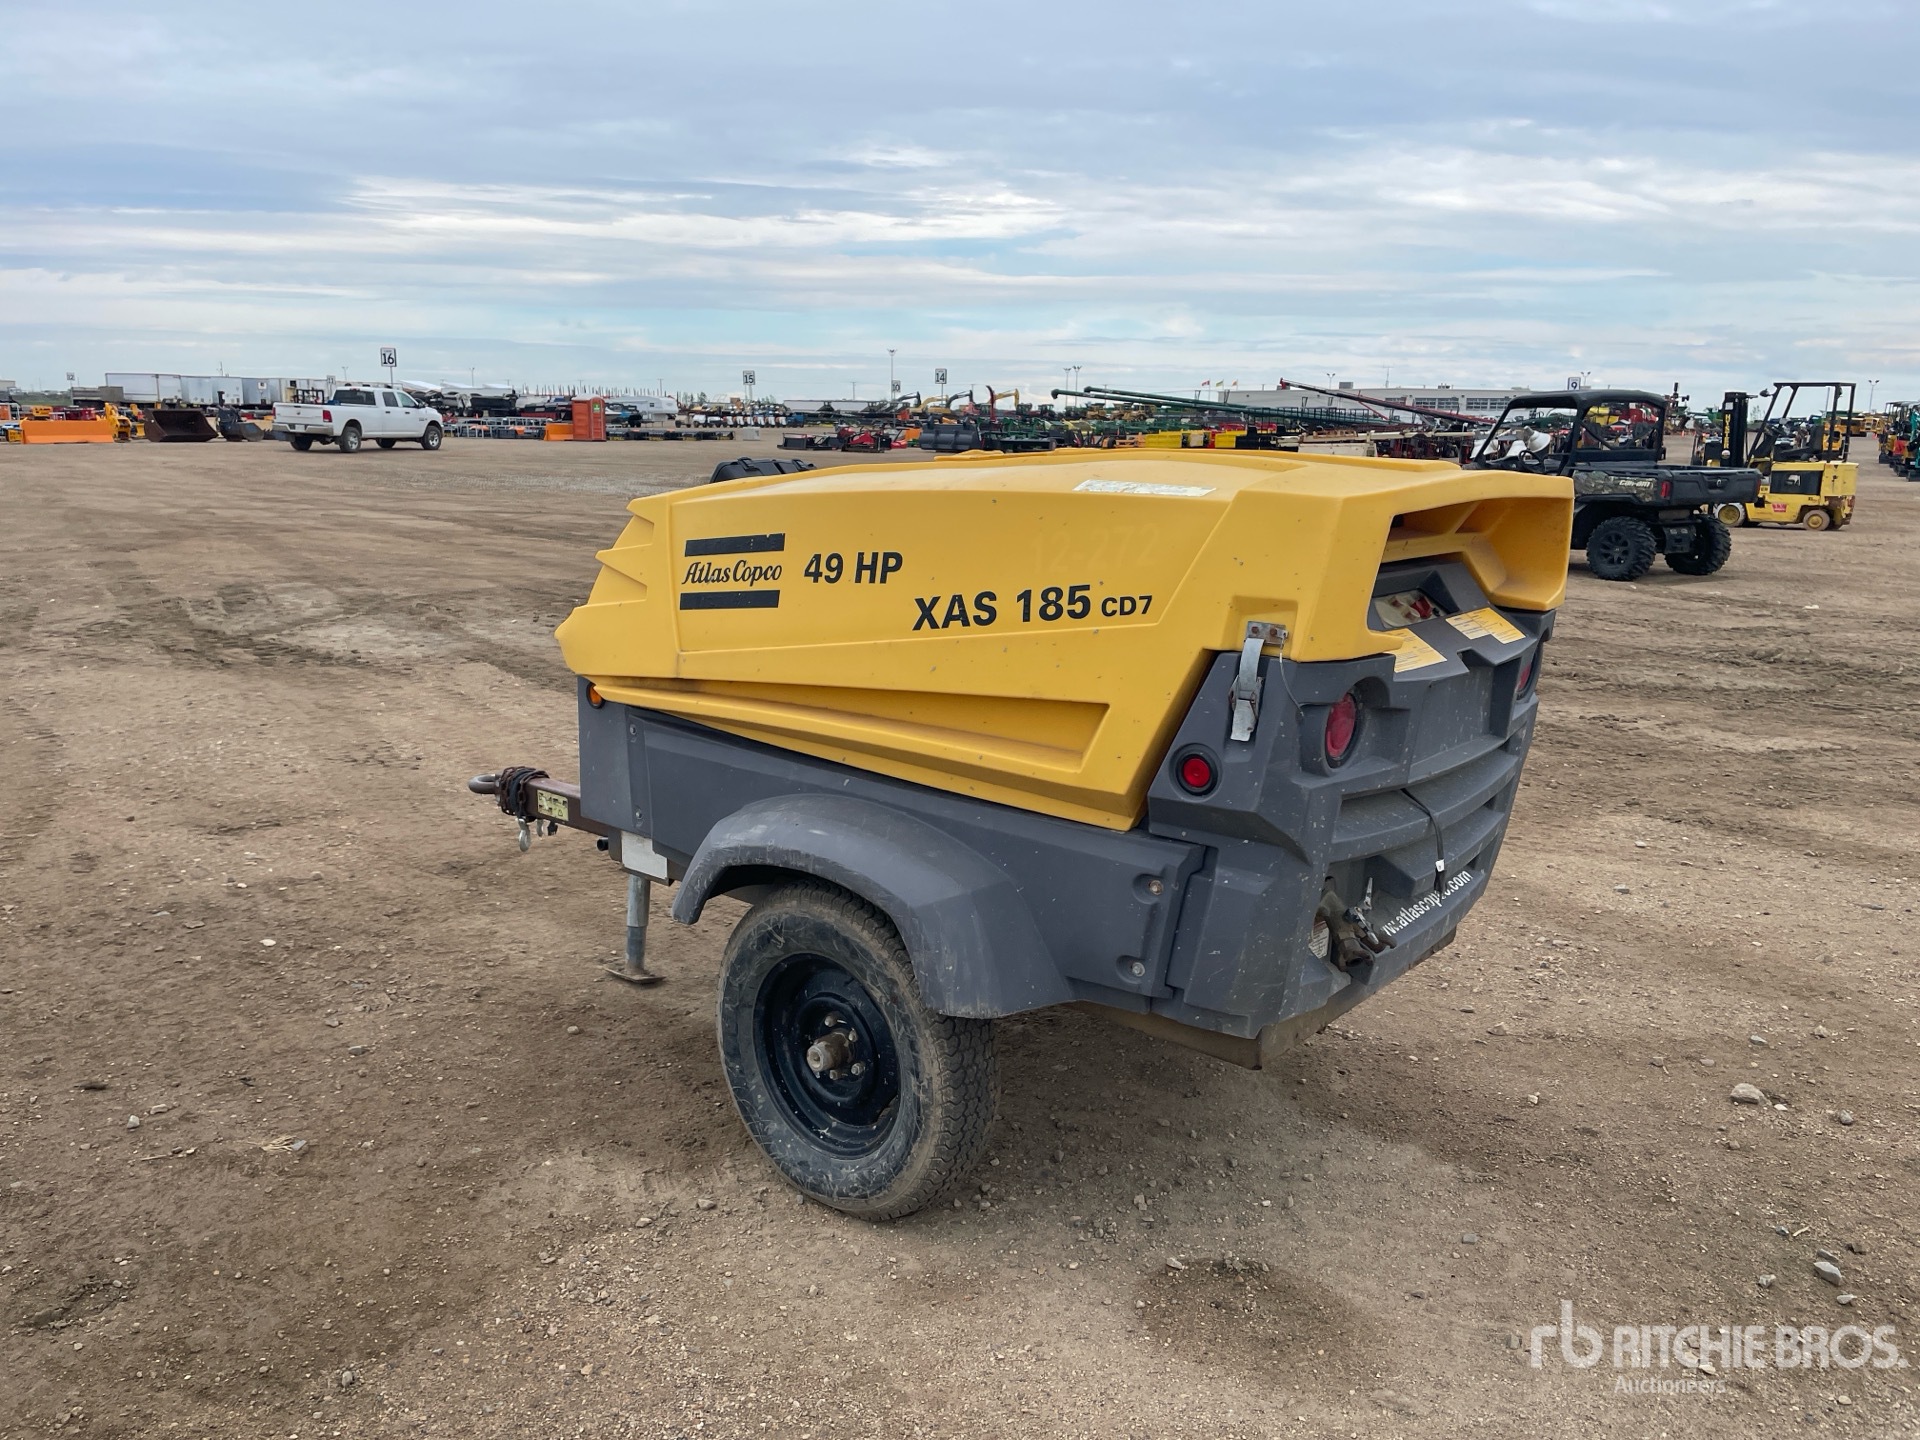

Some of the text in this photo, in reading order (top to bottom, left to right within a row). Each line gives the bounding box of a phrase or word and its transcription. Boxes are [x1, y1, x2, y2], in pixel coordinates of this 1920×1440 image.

[382, 353, 394, 364] 16
[744, 374, 754, 383] 15
[935, 373, 945, 382] 14
[682, 559, 783, 587] Atlas Copco
[803, 551, 904, 585] 49 HP
[912, 584, 1153, 631] XAS 185 CD7
